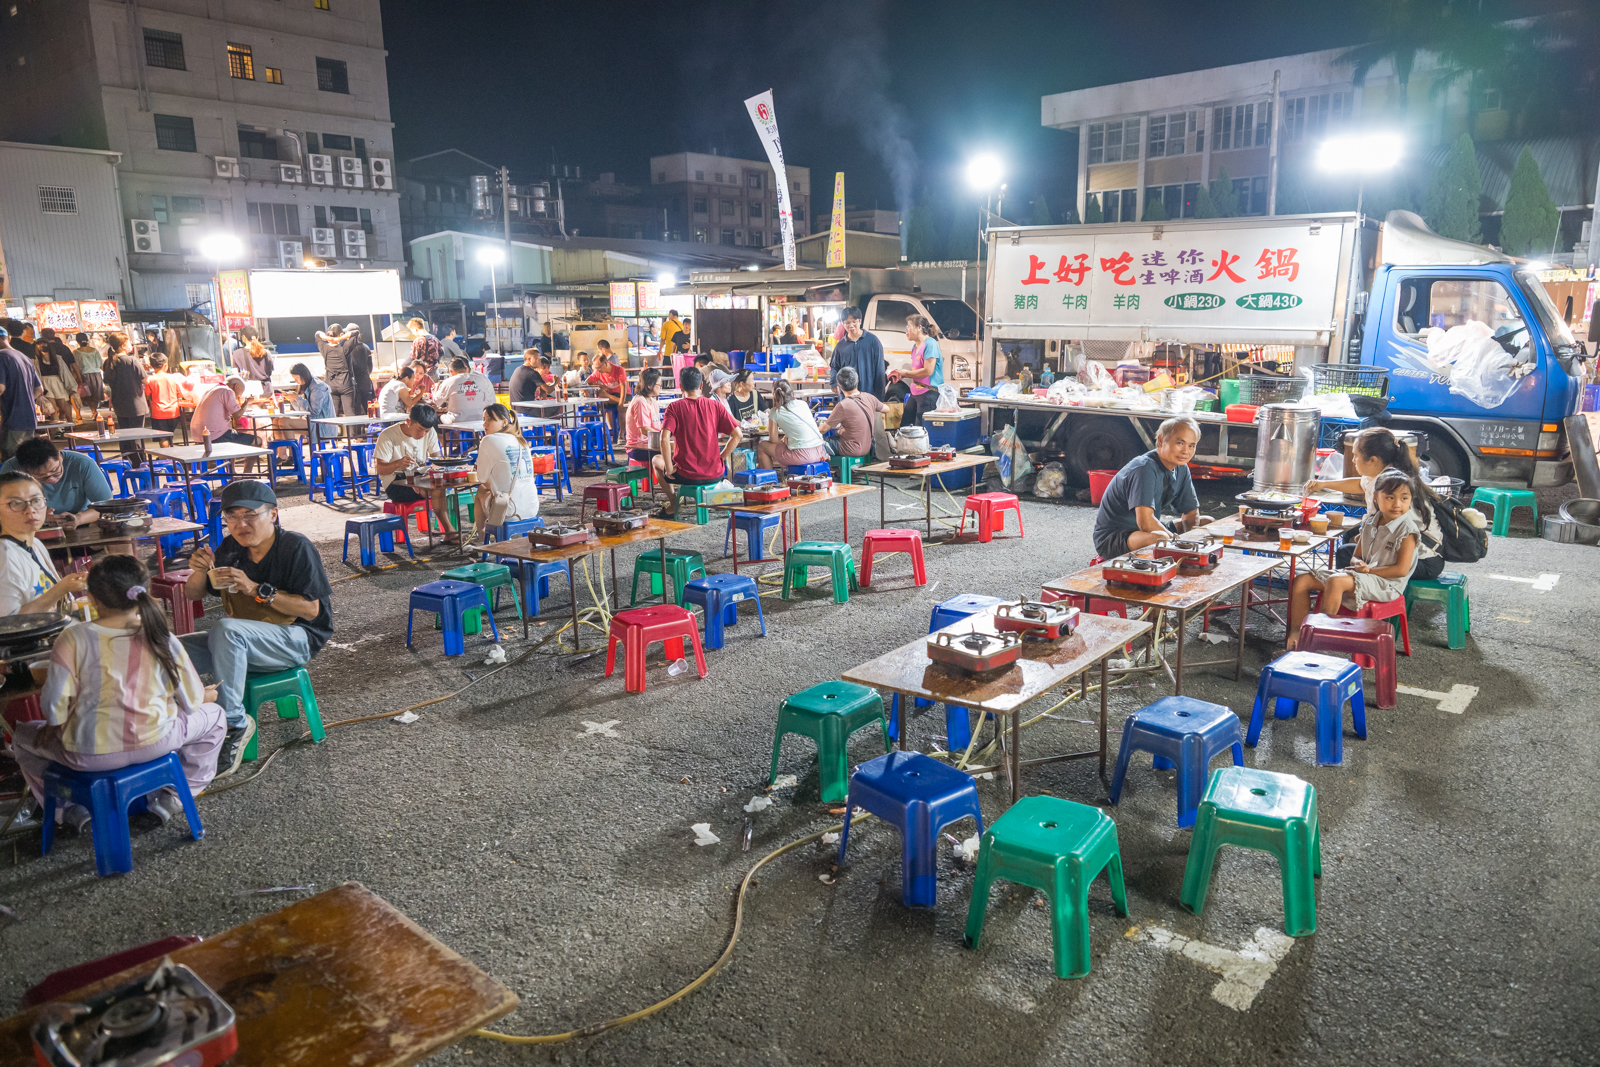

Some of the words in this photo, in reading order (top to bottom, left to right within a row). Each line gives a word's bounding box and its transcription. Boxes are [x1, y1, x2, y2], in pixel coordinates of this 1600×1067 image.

[1141, 249, 1205, 267] 迷你
[1205, 247, 1299, 284] 火鍋
[1020, 251, 1136, 286] 上好吃
[1138, 268, 1204, 286] 生啤酒
[1013, 294, 1038, 310] 豬肉
[1061, 293, 1088, 310] 牛肉
[1113, 293, 1140, 310] 羊肉
[1167, 294, 1220, 309] 小鍋230
[1241, 293, 1298, 309] 大鍋430
